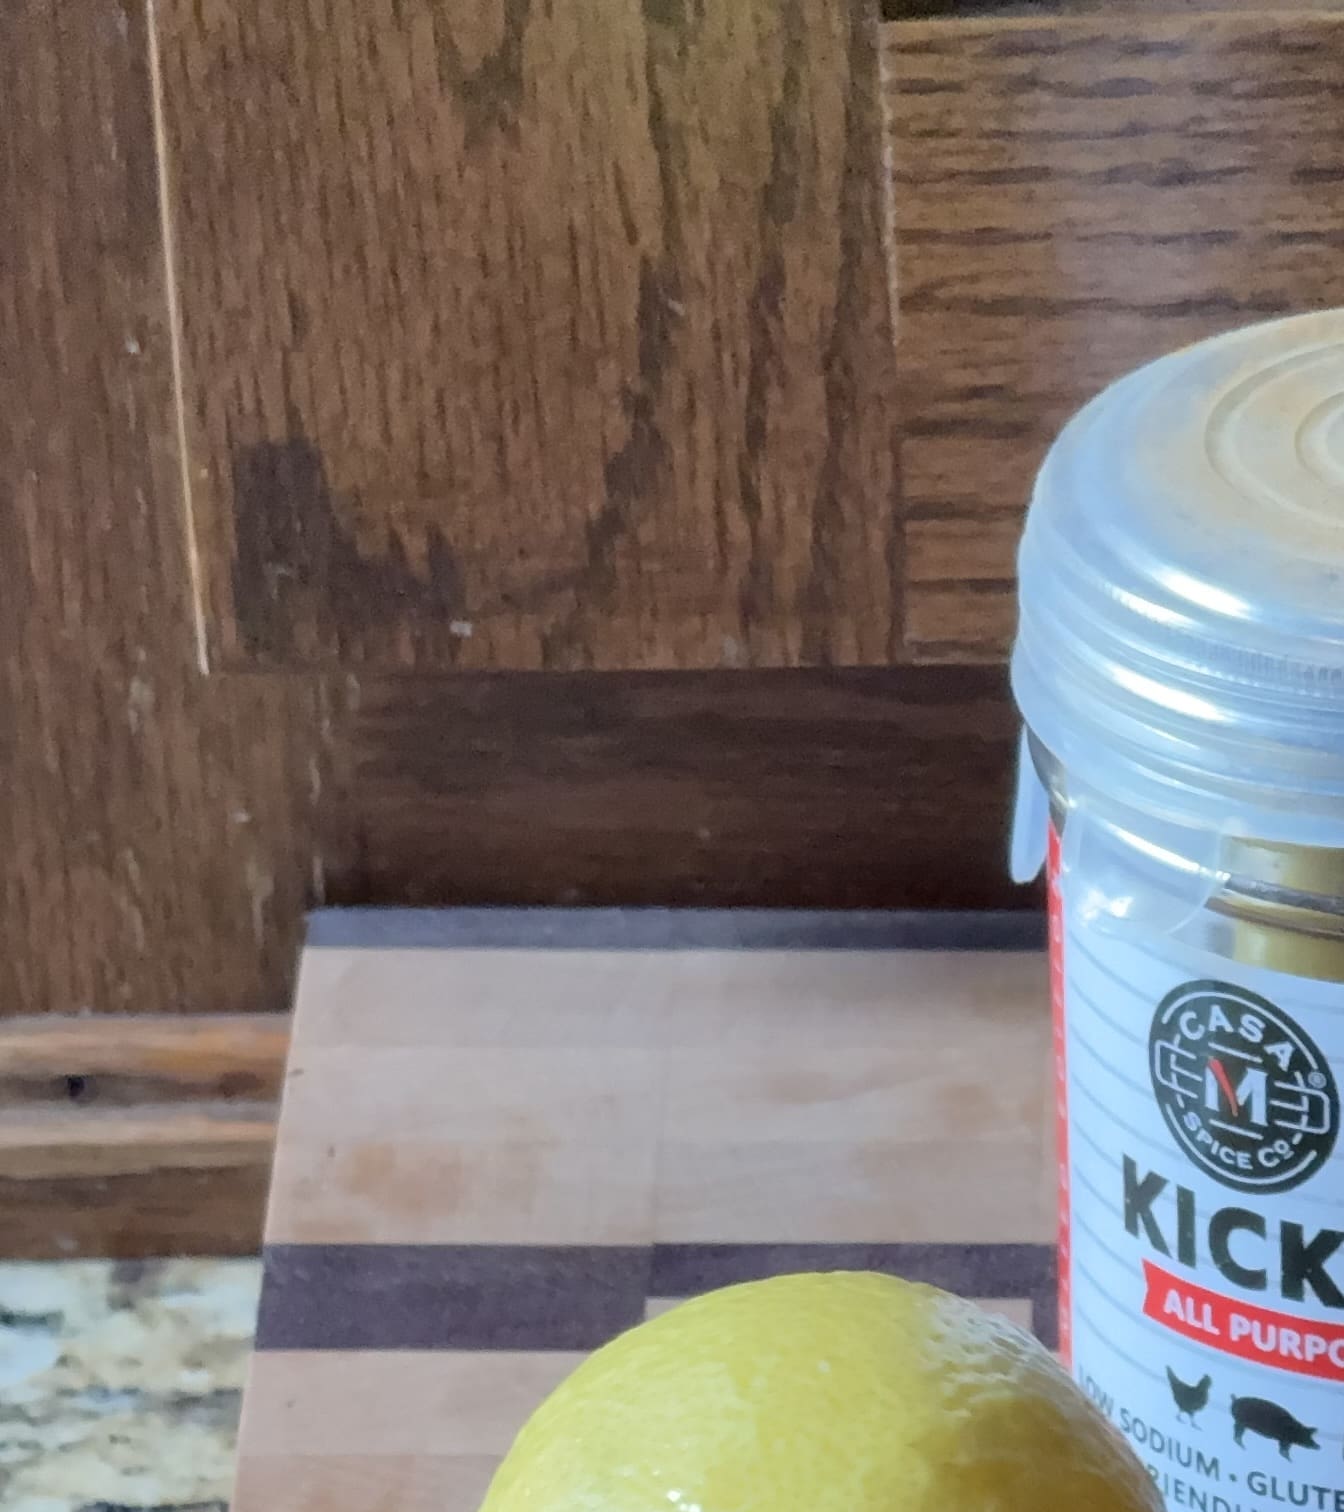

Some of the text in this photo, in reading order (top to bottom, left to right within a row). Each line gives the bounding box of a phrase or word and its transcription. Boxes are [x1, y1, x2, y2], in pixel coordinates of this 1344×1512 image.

[1178, 1003, 1296, 1072] CASA
[1204, 1055, 1269, 1127] M
[1183, 1111, 1254, 1171] SPICE
[1163, 1289, 1220, 1336] ALL
[1120, 1408, 1220, 1482] SODIUM
